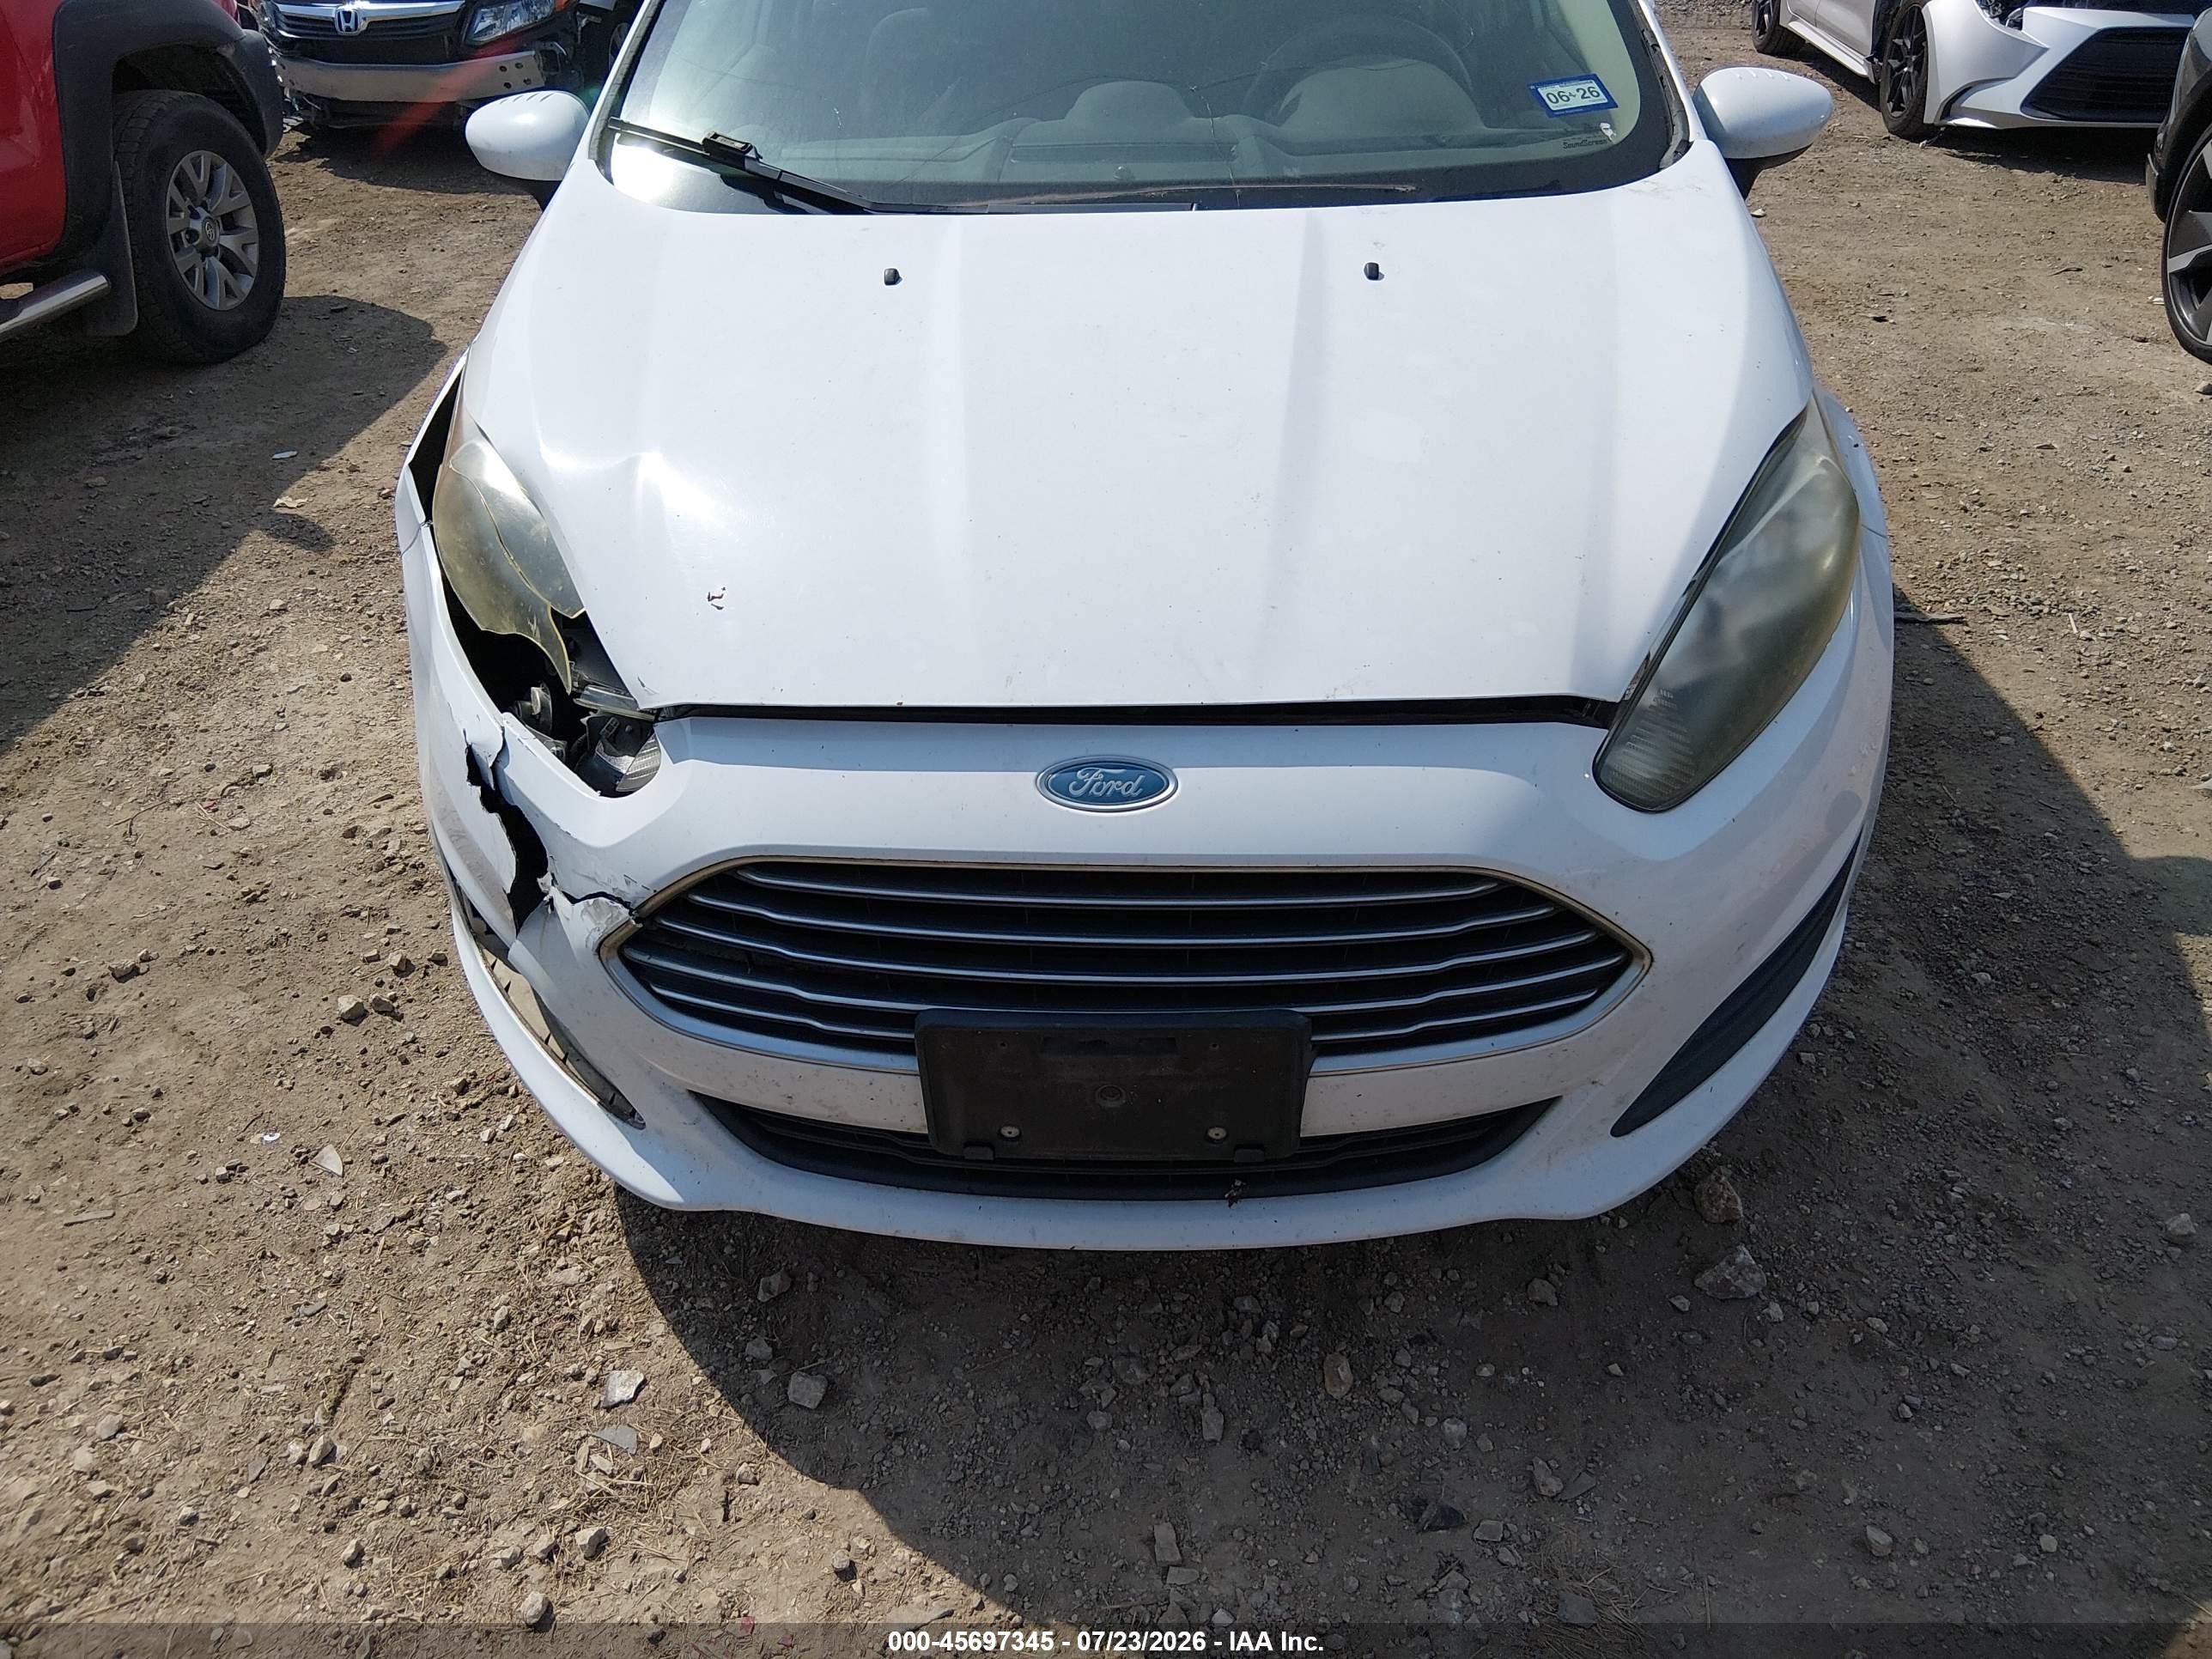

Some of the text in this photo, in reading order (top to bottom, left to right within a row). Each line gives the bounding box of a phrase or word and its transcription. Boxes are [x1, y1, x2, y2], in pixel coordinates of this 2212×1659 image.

[1546, 86, 1601, 104] 06 26
[1068, 767, 1146, 798] Ford
